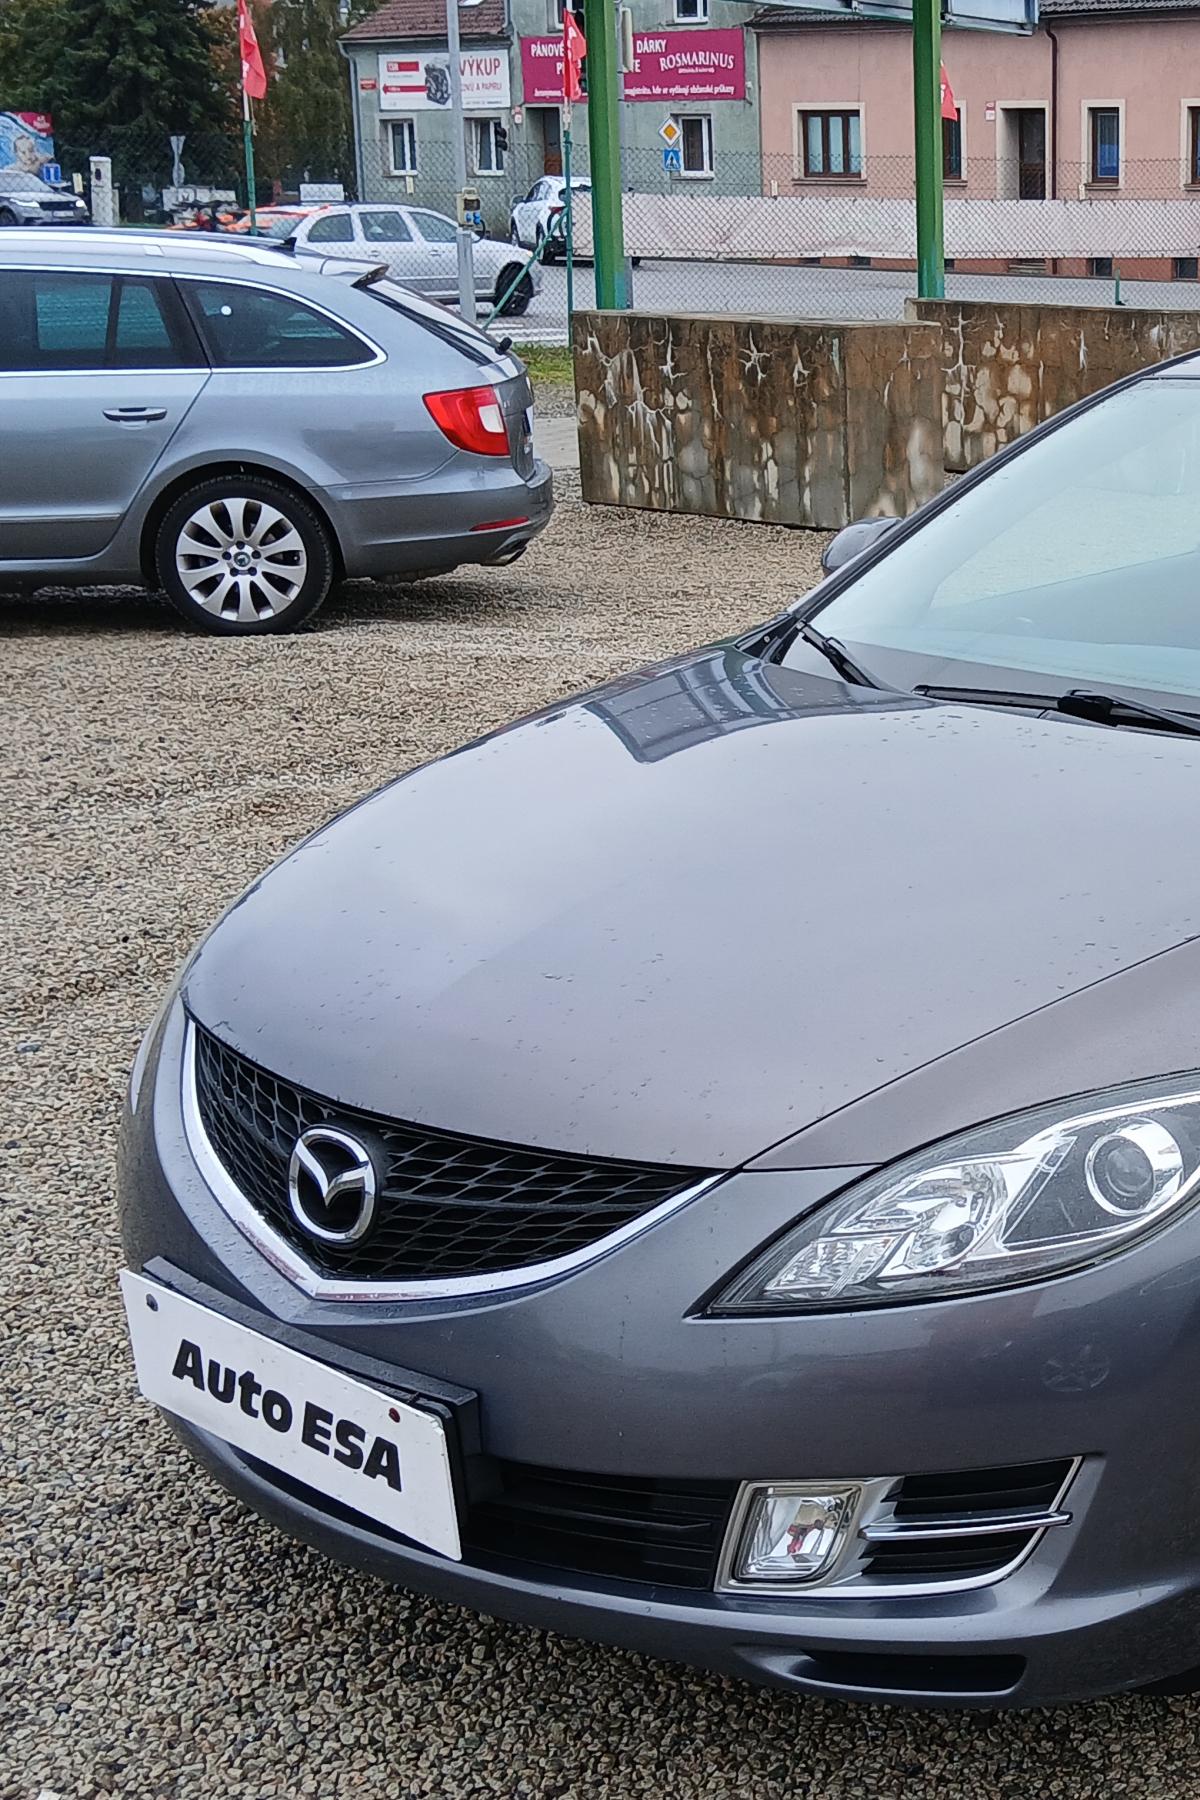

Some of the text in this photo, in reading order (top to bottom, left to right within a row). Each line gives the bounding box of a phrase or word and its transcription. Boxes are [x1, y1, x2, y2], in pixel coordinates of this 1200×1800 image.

[636, 37, 667, 54] DÁRKY
[460, 56, 501, 76] VÝKUP
[659, 51, 735, 72] ROSMARINUS
[171, 1338, 403, 1493] Auto ESA
